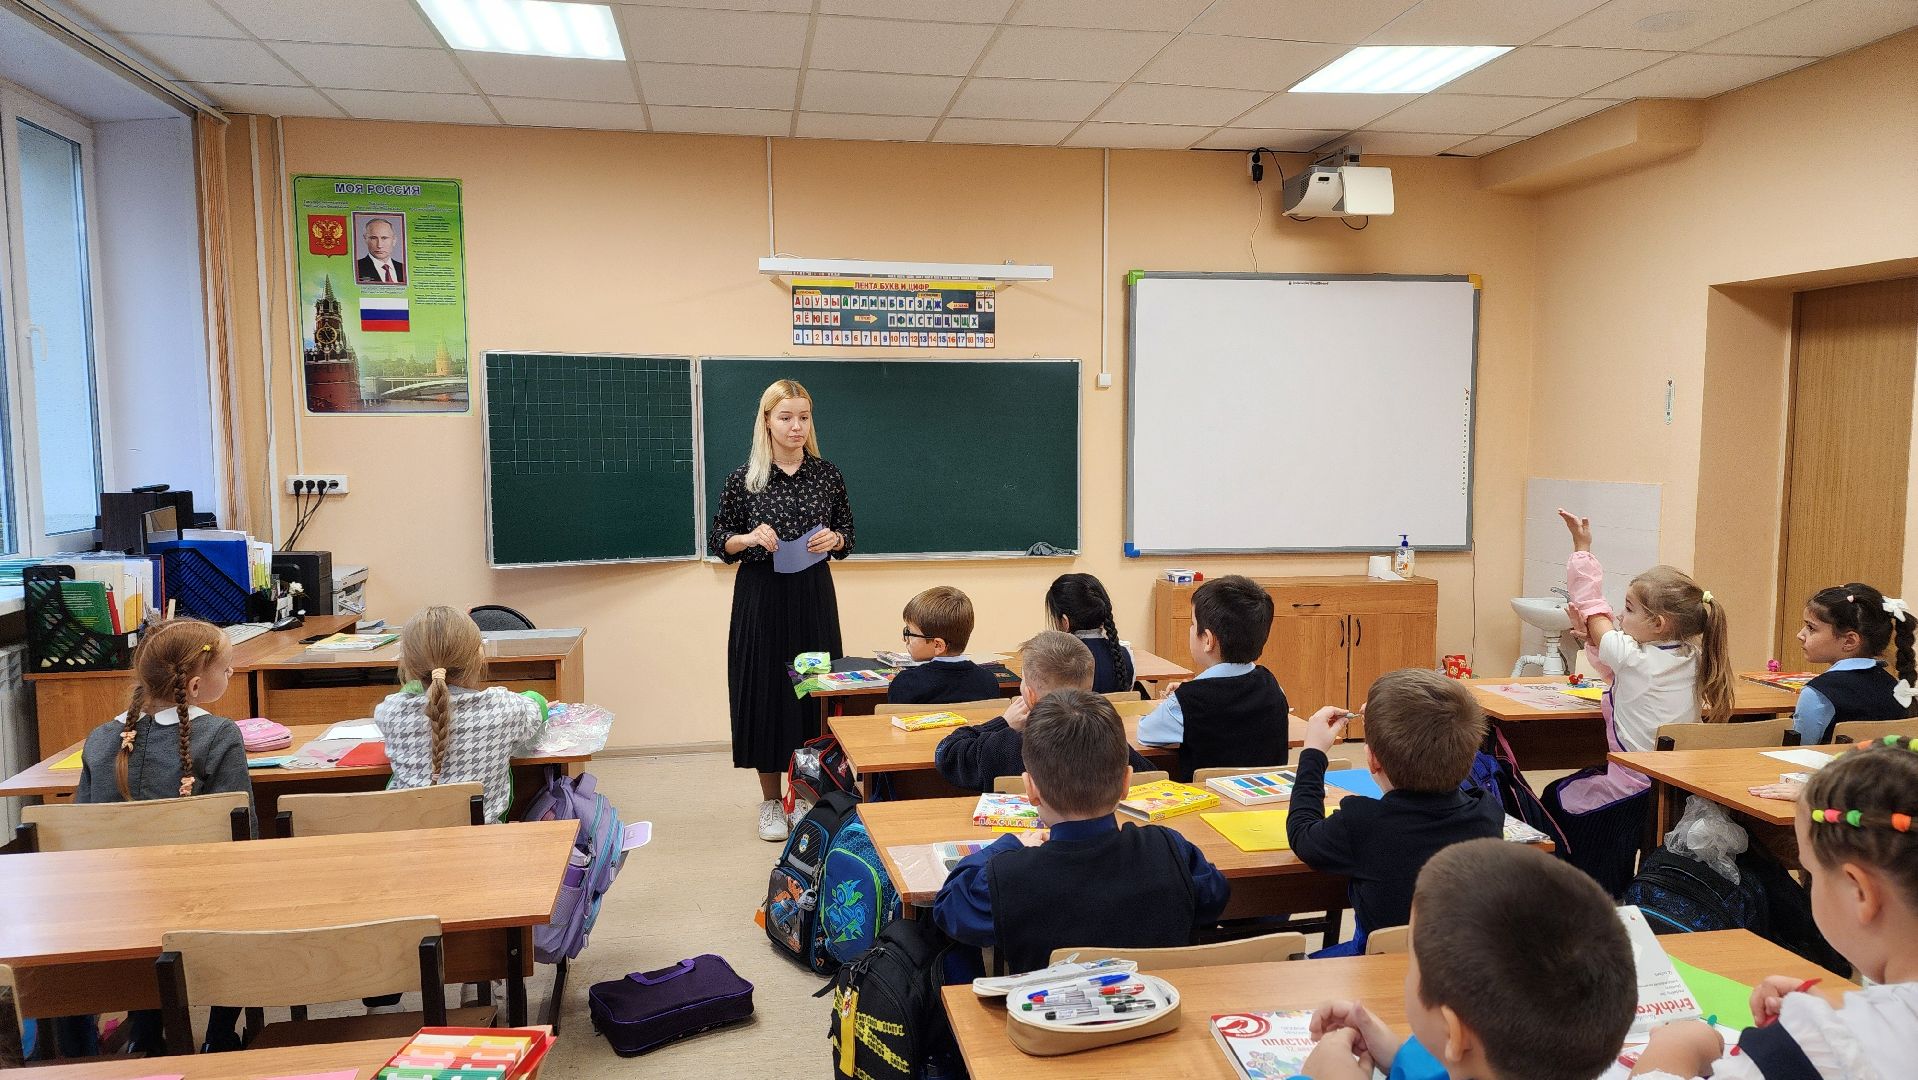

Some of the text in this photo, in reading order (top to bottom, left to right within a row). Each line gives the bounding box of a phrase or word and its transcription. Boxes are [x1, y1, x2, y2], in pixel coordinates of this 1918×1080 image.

[335, 183, 421, 195] МОЯ РОССИЯ
[909, 284, 929, 292] ЦИФР
[795, 297, 800, 305] А
[805, 297, 810, 305] О
[824, 298, 829, 306] Э
[832, 298, 839, 306] Ы
[843, 295, 848, 306] Й
[852, 298, 857, 306] Р
[861, 299, 867, 307] Л
[870, 299, 877, 307] М
[880, 299, 886, 307] Н
[926, 300, 932, 310] Д
[934, 300, 941, 309] Ж
[805, 312, 809, 322] Ё
[890, 317, 895, 325] П
[898, 316, 905, 324] Ф
[918, 317, 923, 325] С
[927, 317, 932, 325] Т
[935, 317, 941, 325] Ш
[944, 317, 950, 327] Ц
[962, 317, 969, 327] Щ
[972, 317, 977, 326] Х
[979, 818, 1038, 827] ПЛАСТИЛИН
[1634, 998, 1696, 1016] ErichKra
